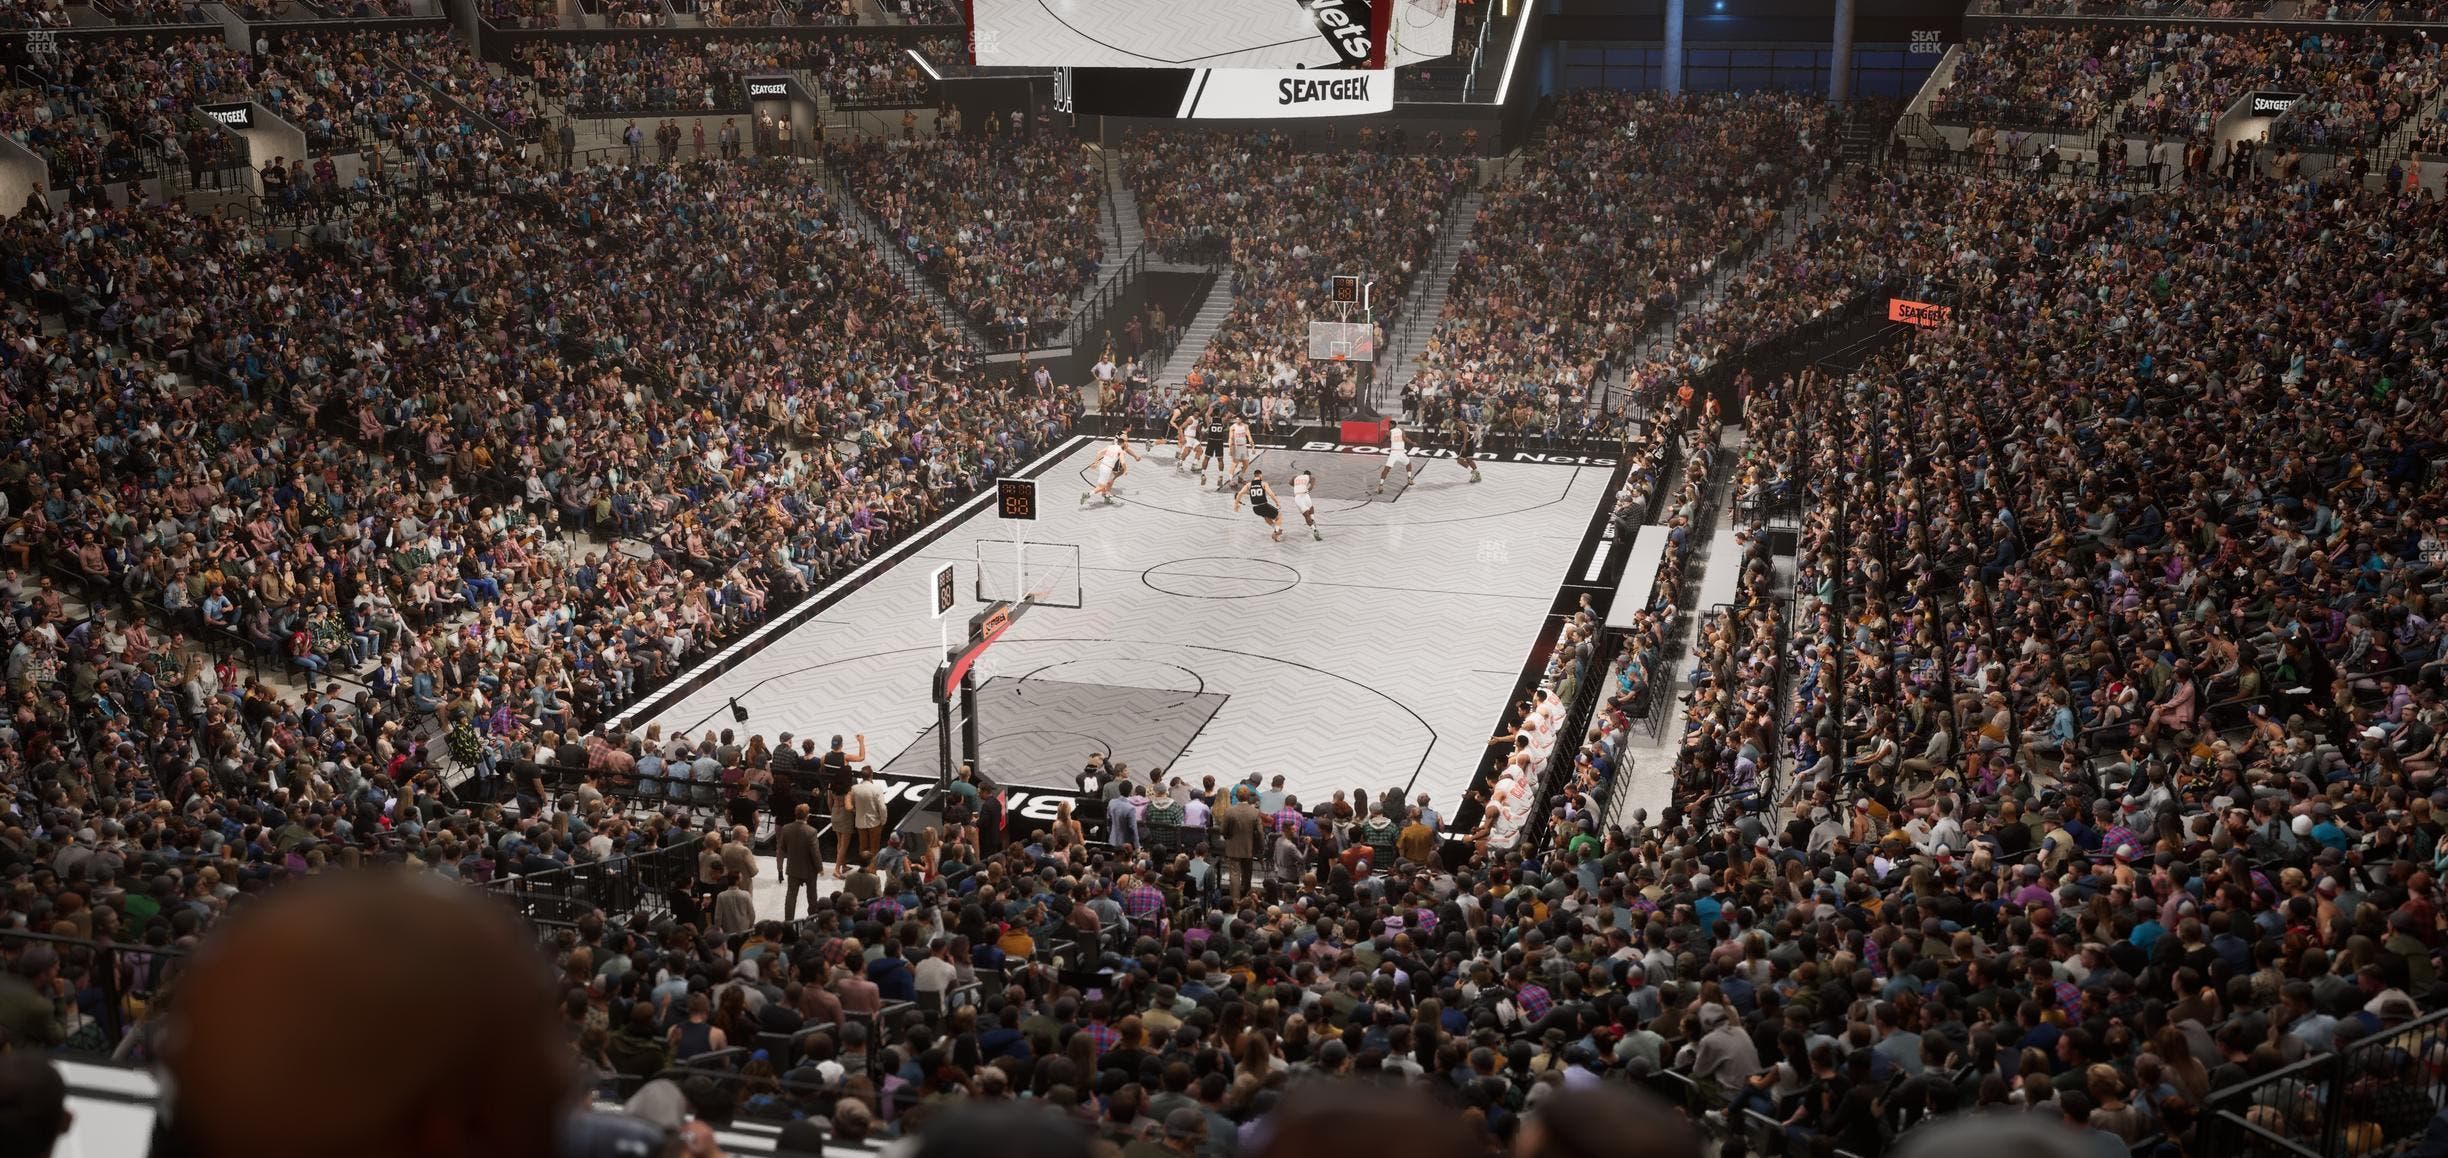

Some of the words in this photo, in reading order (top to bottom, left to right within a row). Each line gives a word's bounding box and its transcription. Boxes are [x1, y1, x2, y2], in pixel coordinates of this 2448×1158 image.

[751, 83, 787, 95] SEATGEEK
[1279, 74, 1370, 105] SEATGEEK
[1513, 452, 1617, 466] Nets
